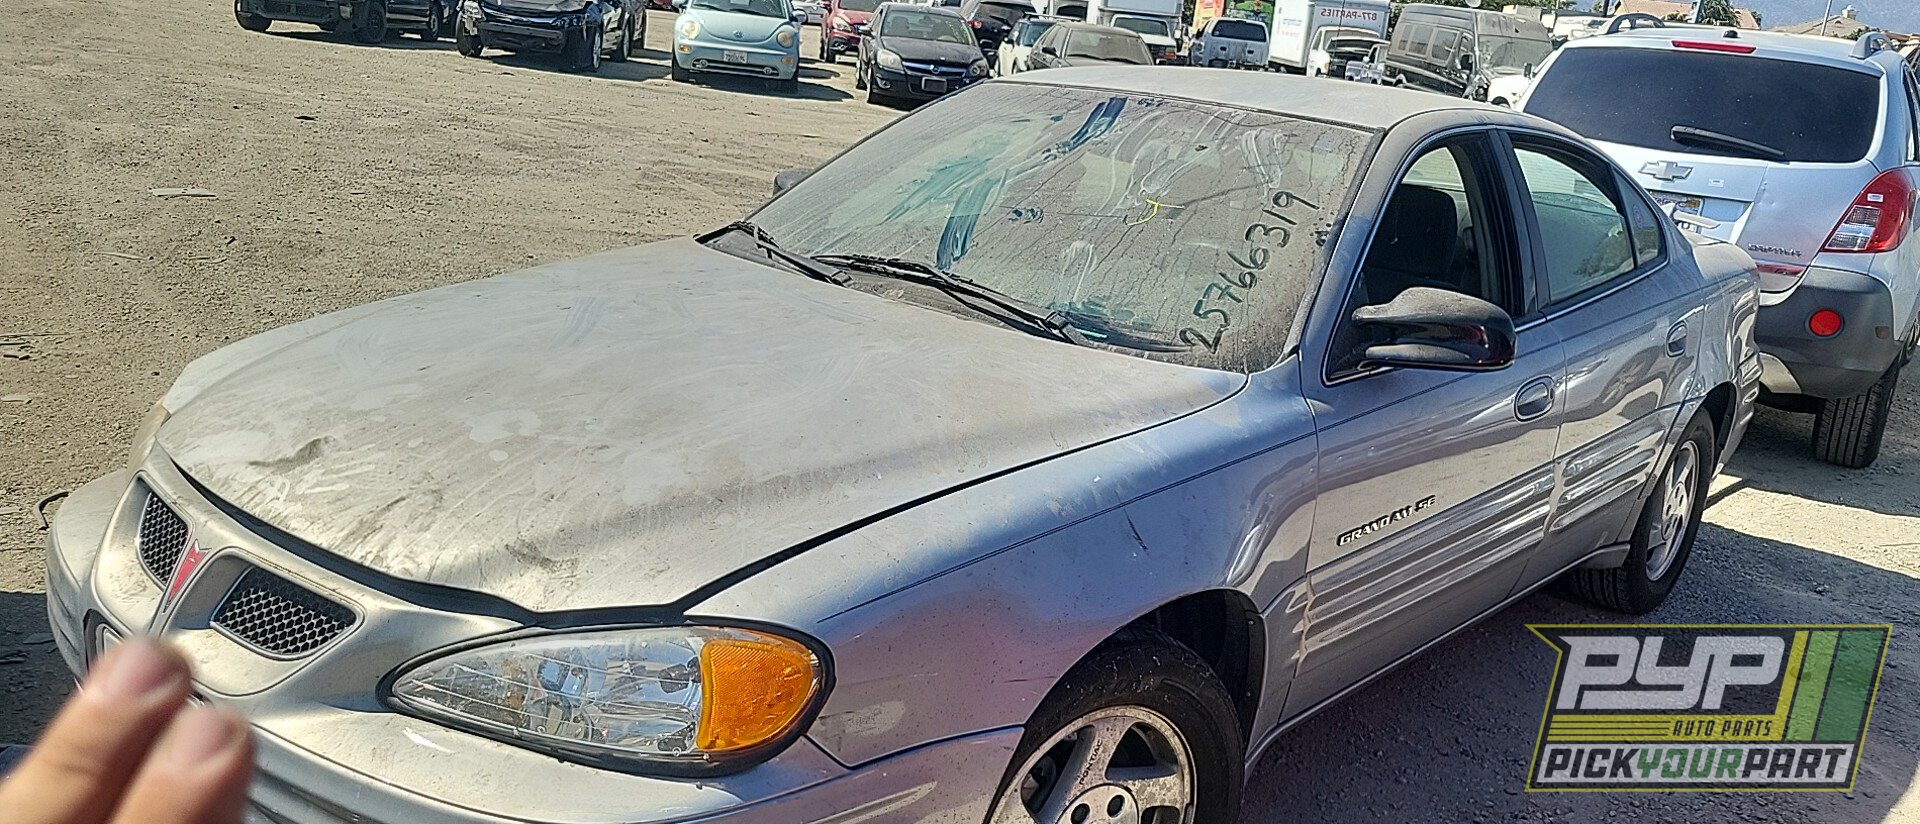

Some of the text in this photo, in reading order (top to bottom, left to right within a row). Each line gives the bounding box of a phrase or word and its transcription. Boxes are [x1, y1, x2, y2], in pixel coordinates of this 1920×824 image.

[1179, 190, 1320, 355] 25766319
[1415, 495, 1437, 512] SE
[1079, 738, 1103, 785] PONTIAC
